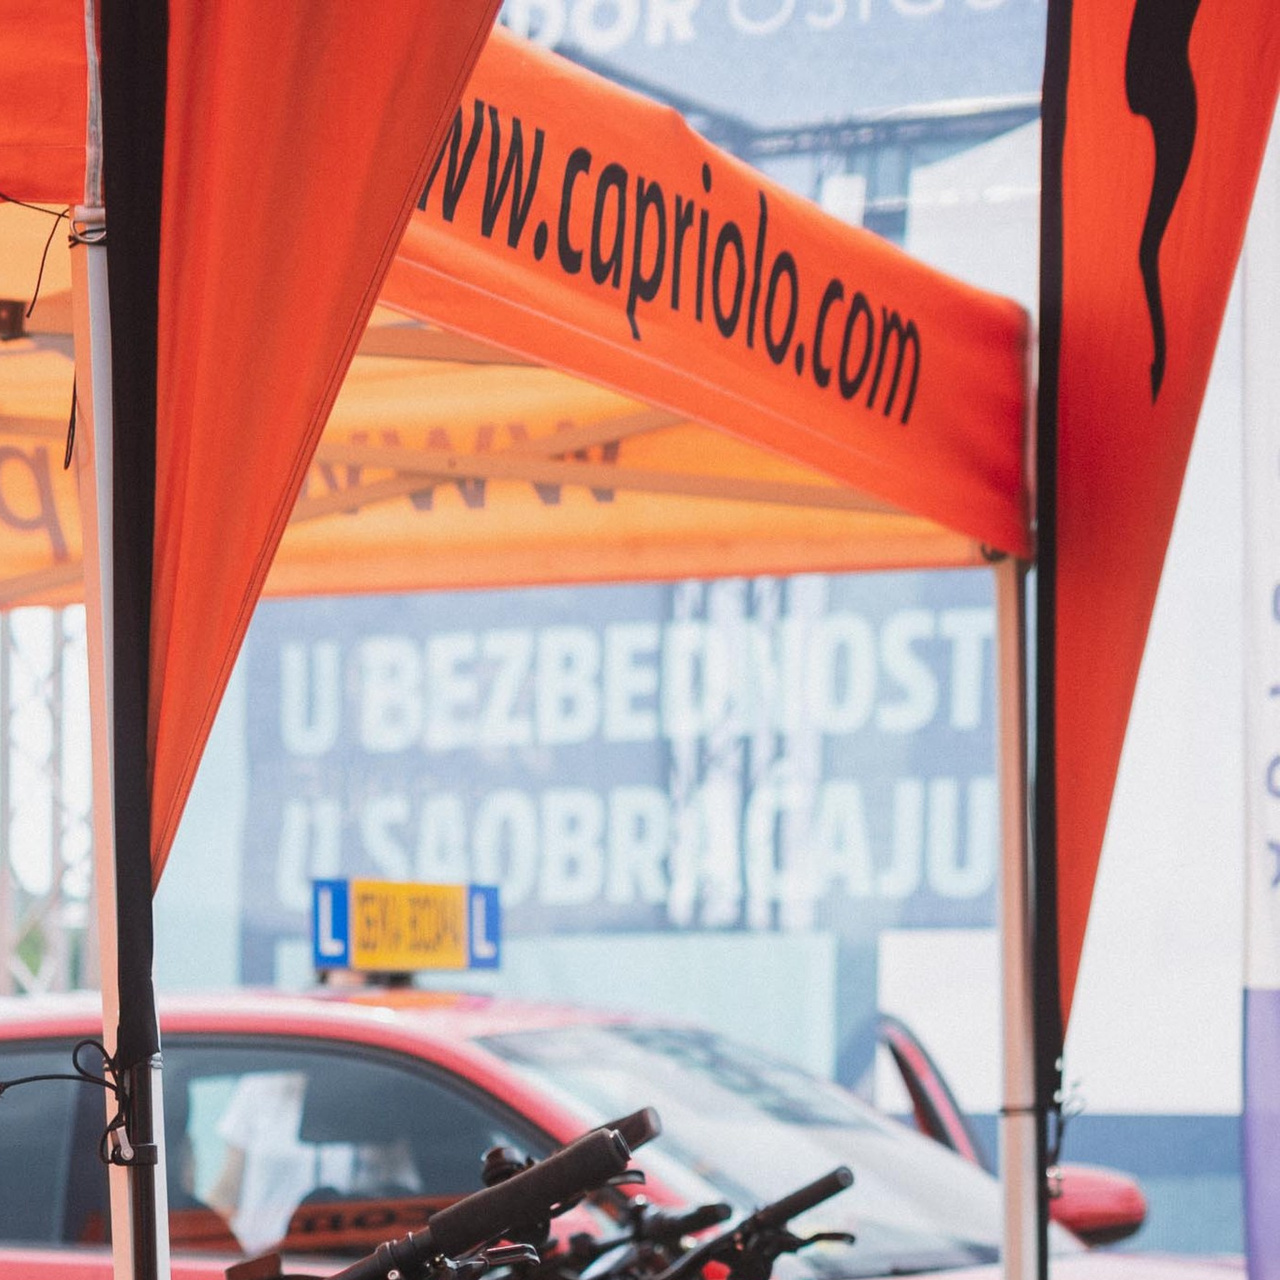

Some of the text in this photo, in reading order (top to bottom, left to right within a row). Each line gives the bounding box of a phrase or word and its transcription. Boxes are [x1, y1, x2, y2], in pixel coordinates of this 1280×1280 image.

[417, 98, 922, 425] ww.capriolo.com
[280, 638, 340, 756] U
[318, 886, 345, 957] L
[471, 892, 498, 959] L
